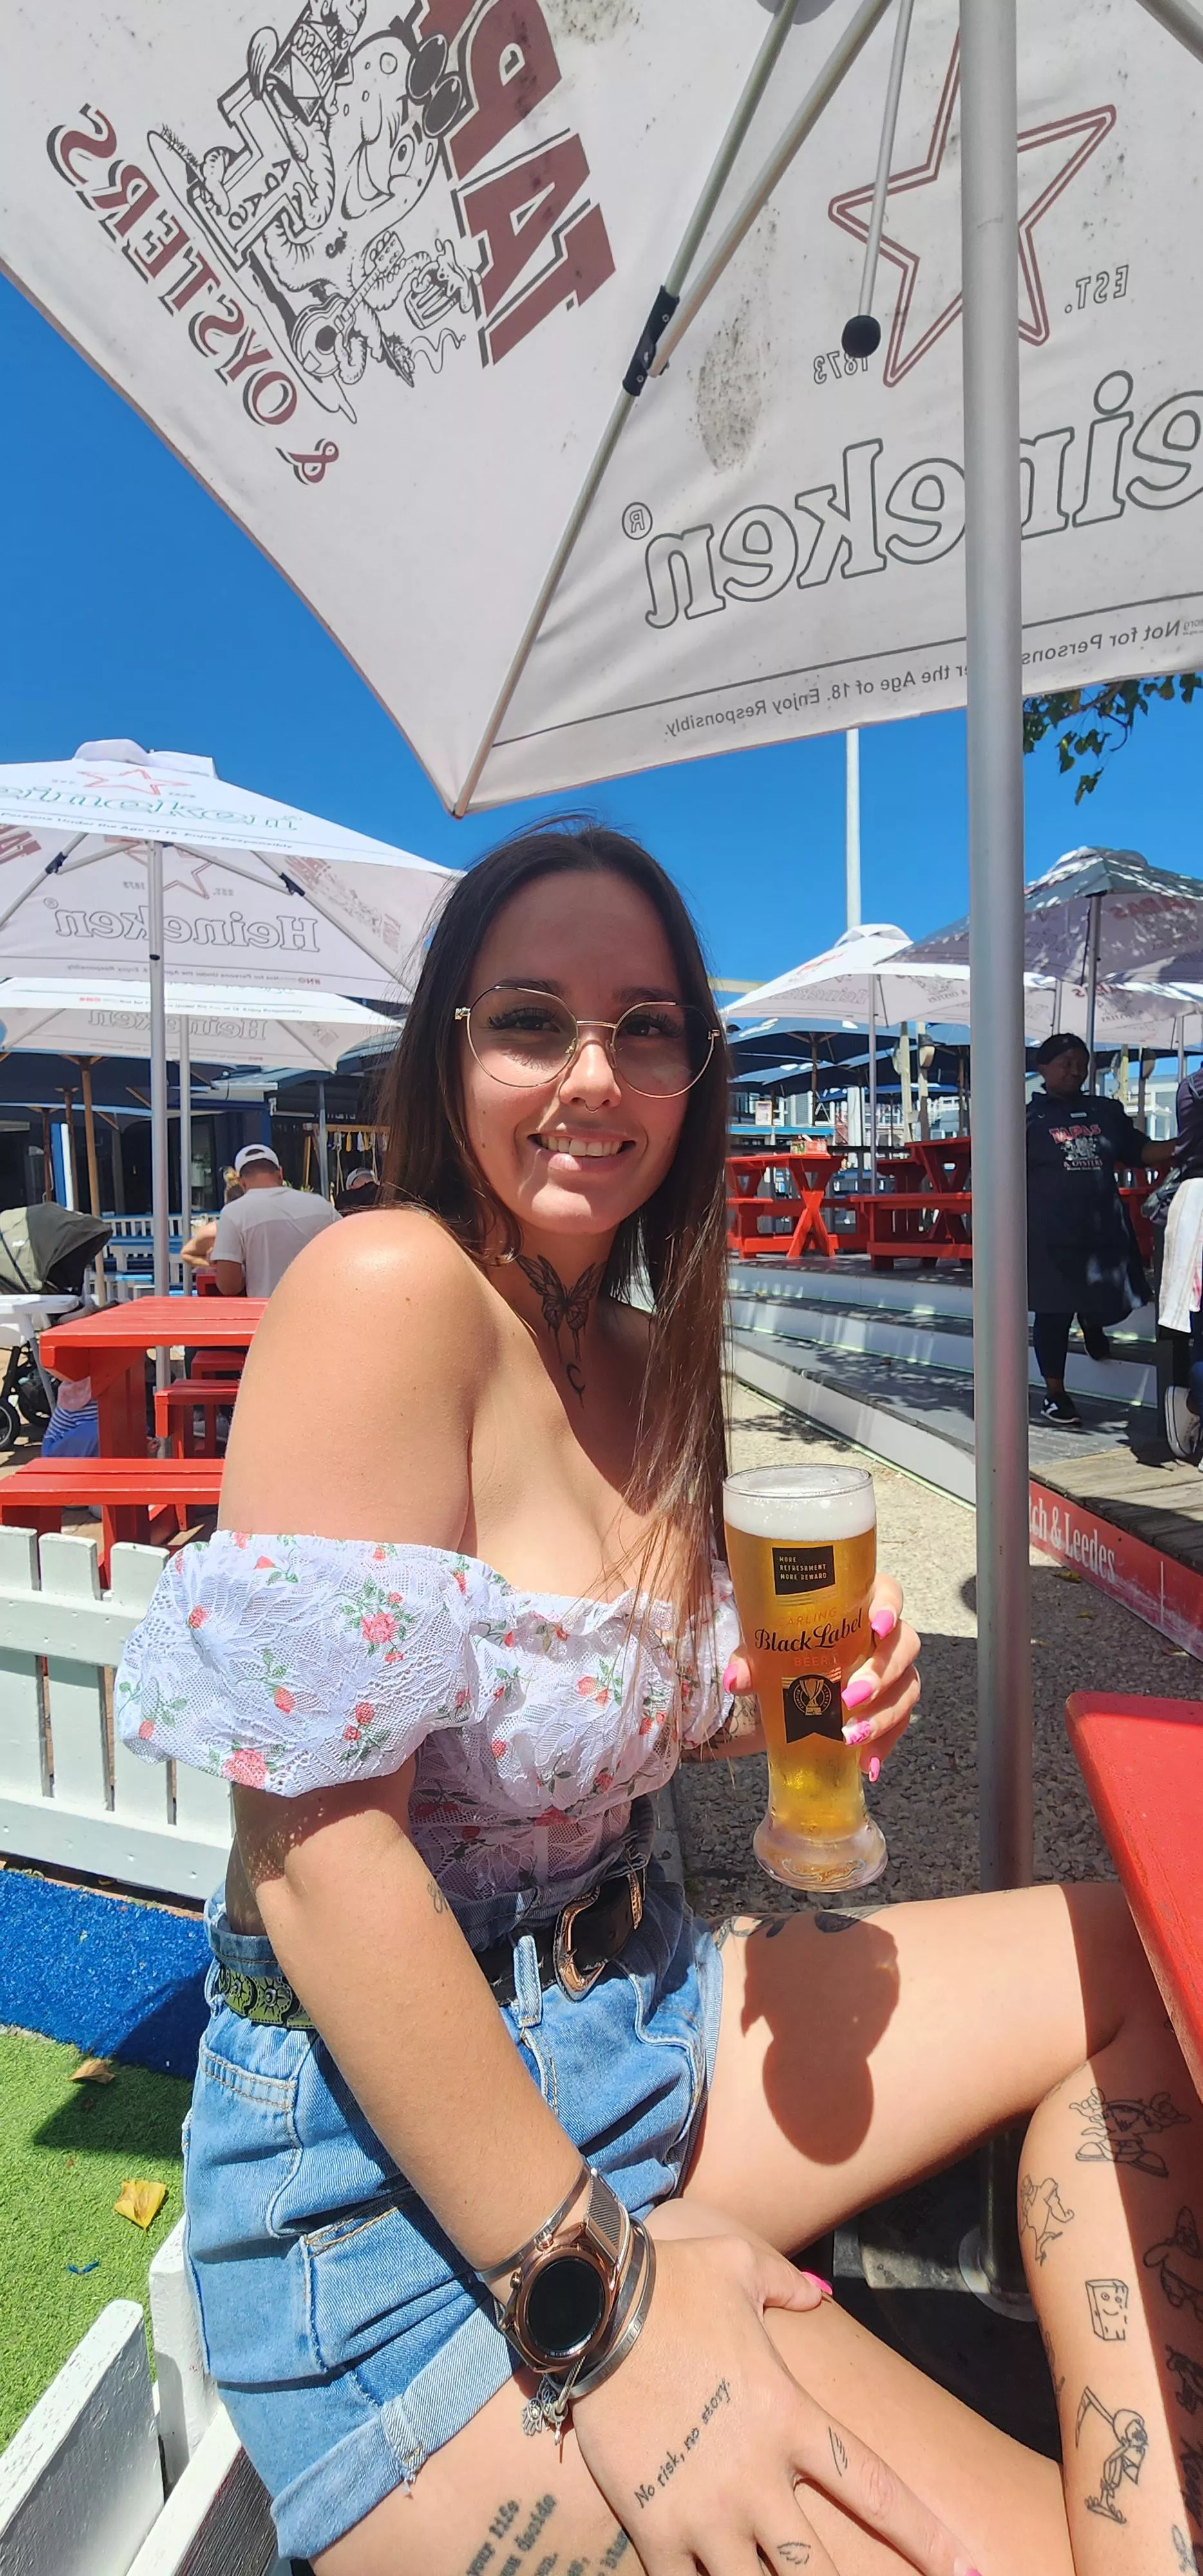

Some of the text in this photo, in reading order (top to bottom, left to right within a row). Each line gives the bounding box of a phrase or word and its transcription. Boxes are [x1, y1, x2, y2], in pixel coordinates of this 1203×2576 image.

[1050, 1505, 1063, 1550] &
[1064, 1511, 1115, 1584] Leedes
[800, 1572, 827, 1580] REWARD
[754, 1607, 862, 1653] Black Label
[793, 1656, 828, 1667] BEER
[634, 2377, 731, 2509] No risk, no story.
